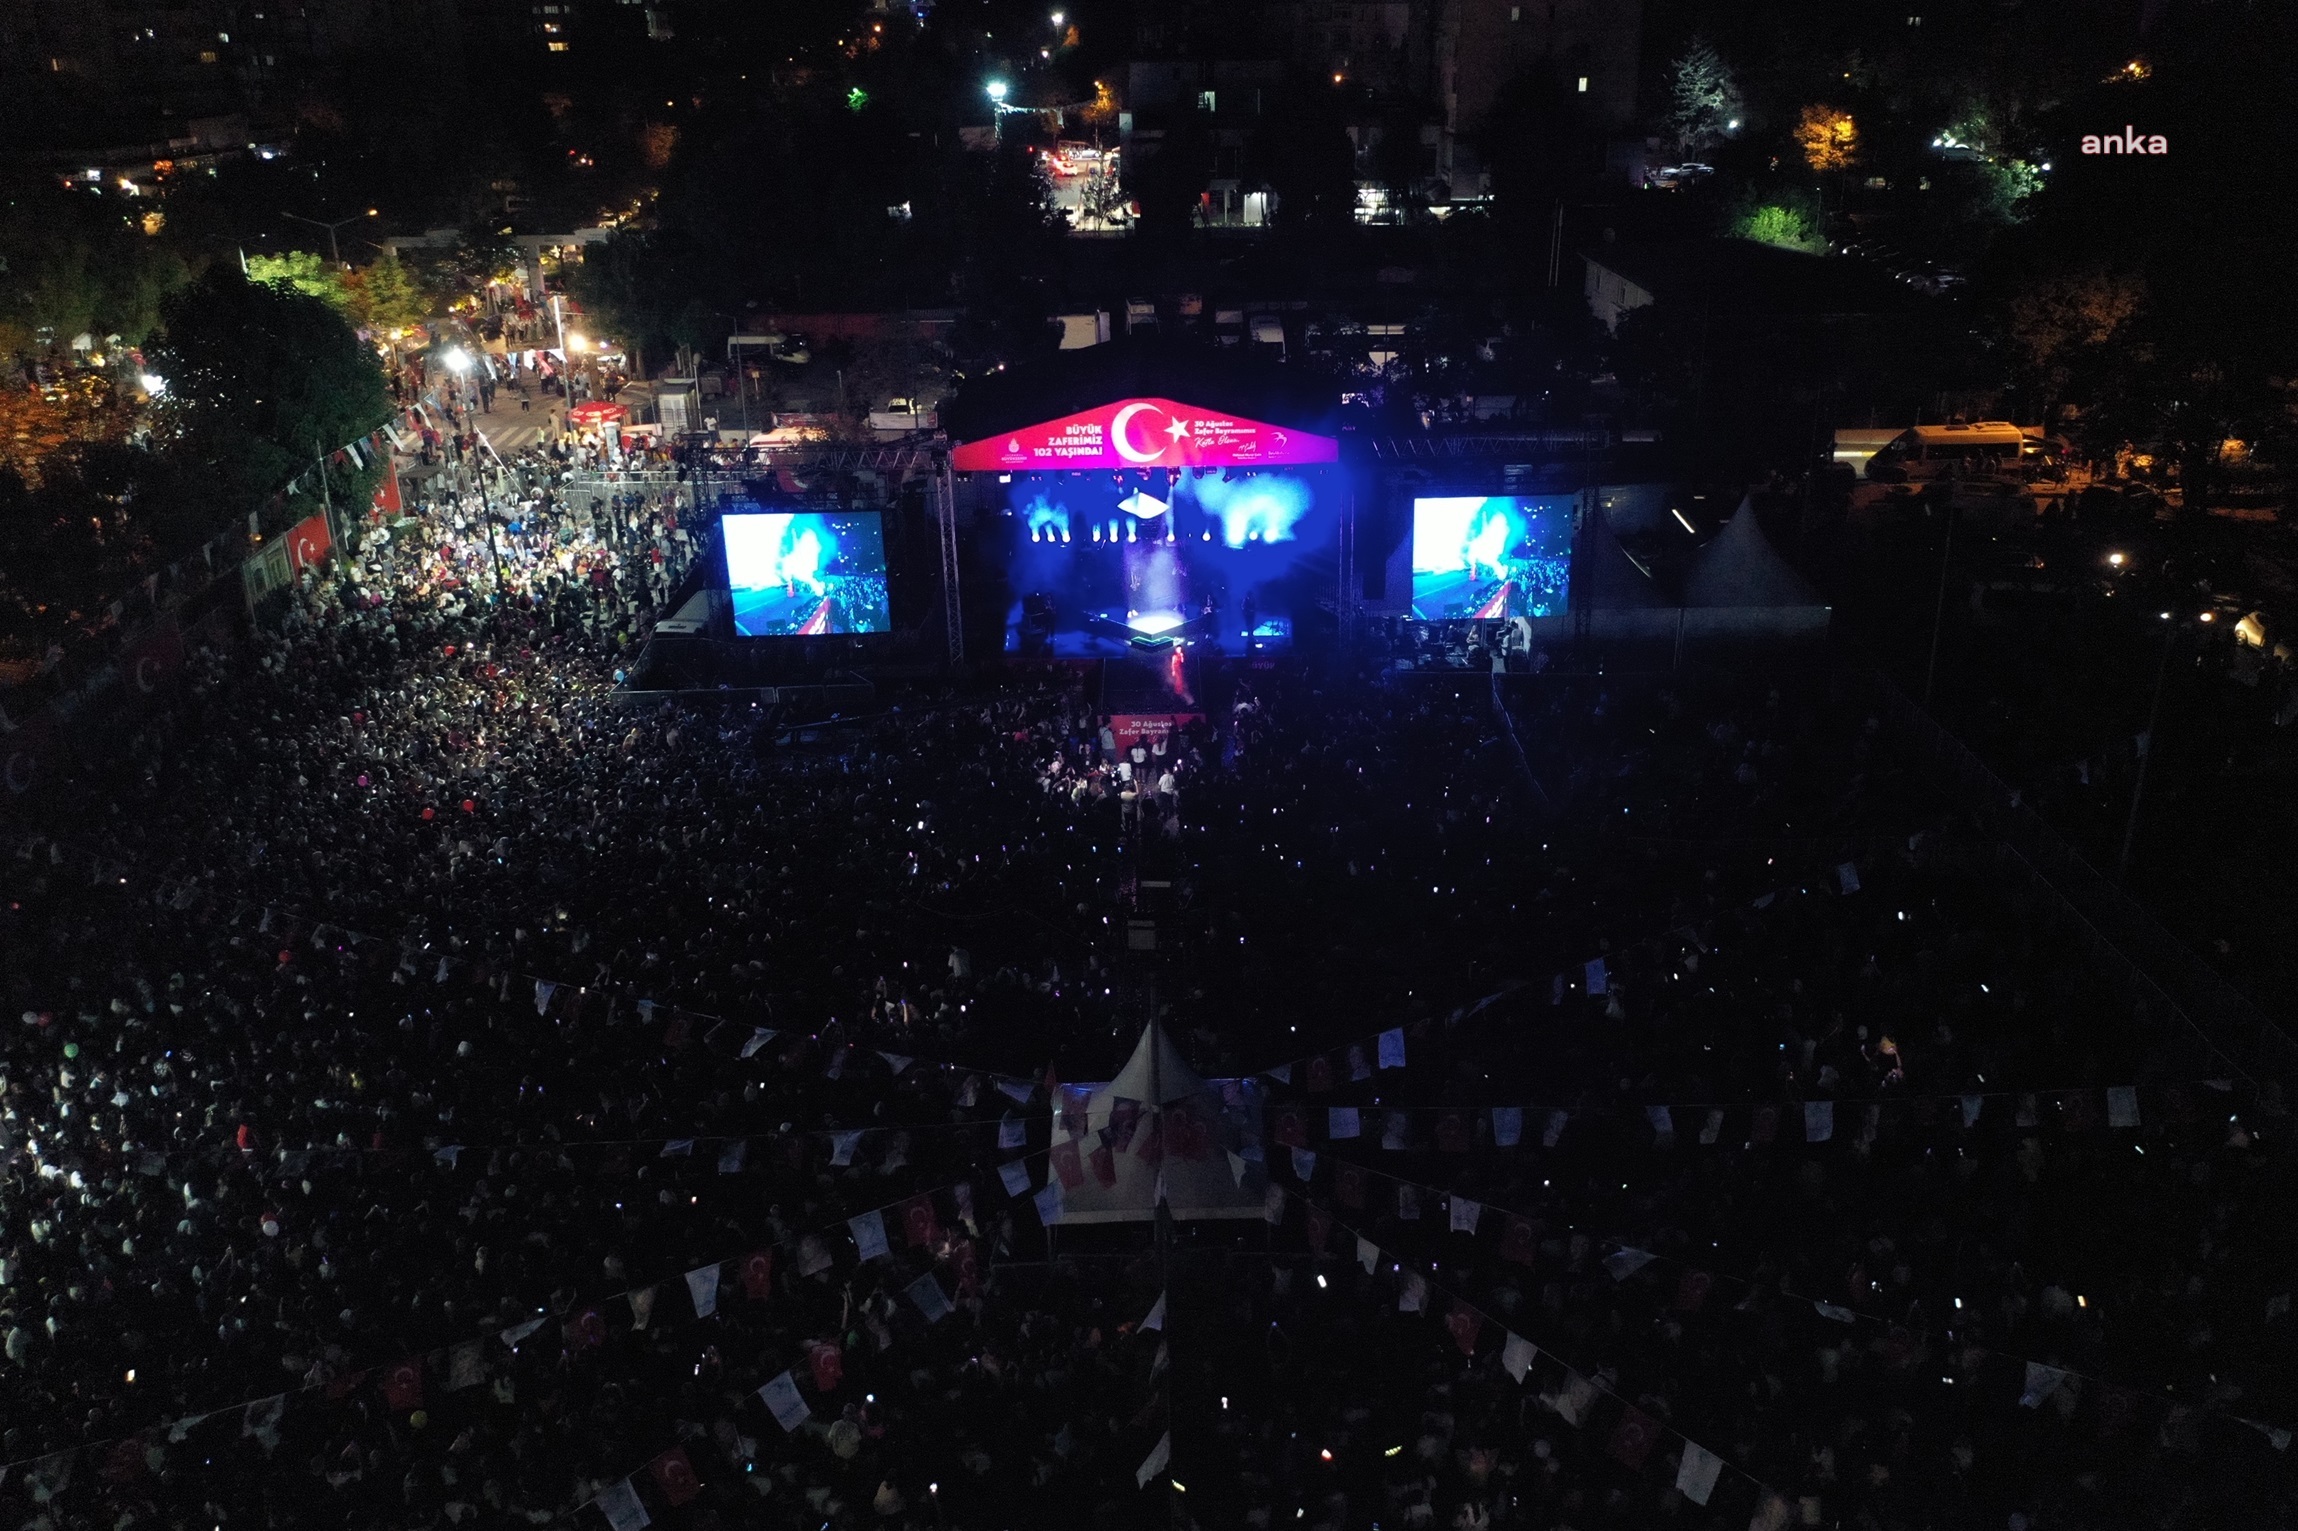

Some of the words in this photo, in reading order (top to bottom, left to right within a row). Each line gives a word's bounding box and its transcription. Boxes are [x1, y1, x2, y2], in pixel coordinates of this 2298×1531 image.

[1066, 424, 1102, 435] BÜYÜK
[1048, 434, 1103, 446] ZAFERİMİZ
[1033, 448, 1052, 457] 102
[1054, 447, 1103, 459] YAŞINDA!
[1143, 721, 1172, 729] Ağustos
[1119, 728, 1140, 736] Zafer
